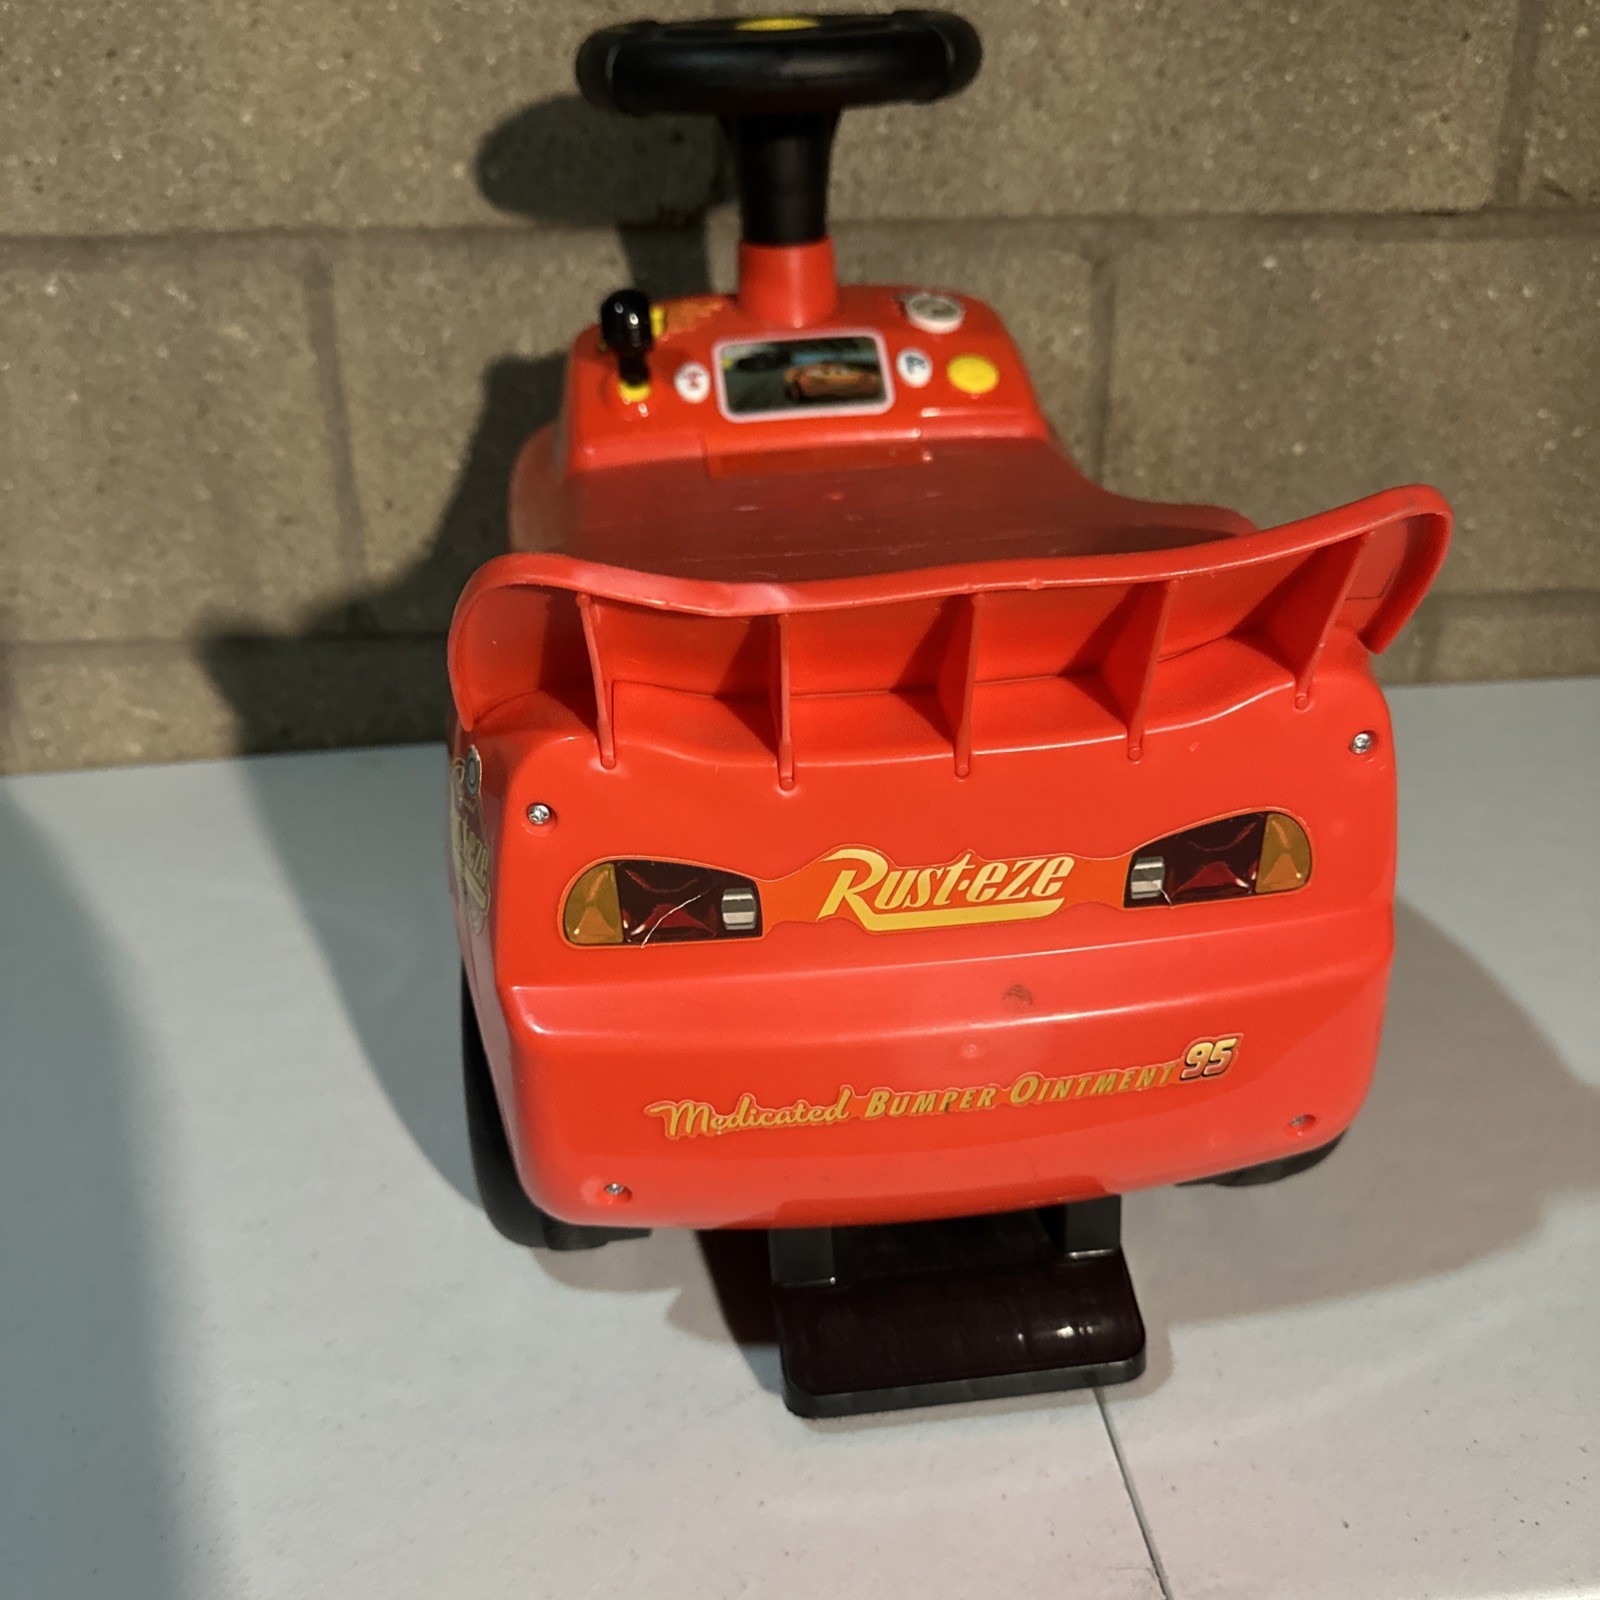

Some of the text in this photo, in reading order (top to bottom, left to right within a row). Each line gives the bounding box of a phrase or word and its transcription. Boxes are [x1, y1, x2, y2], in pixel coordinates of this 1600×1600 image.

[648, 1036, 1239, 1137] Medicated BUMPER OINTMENT 95
